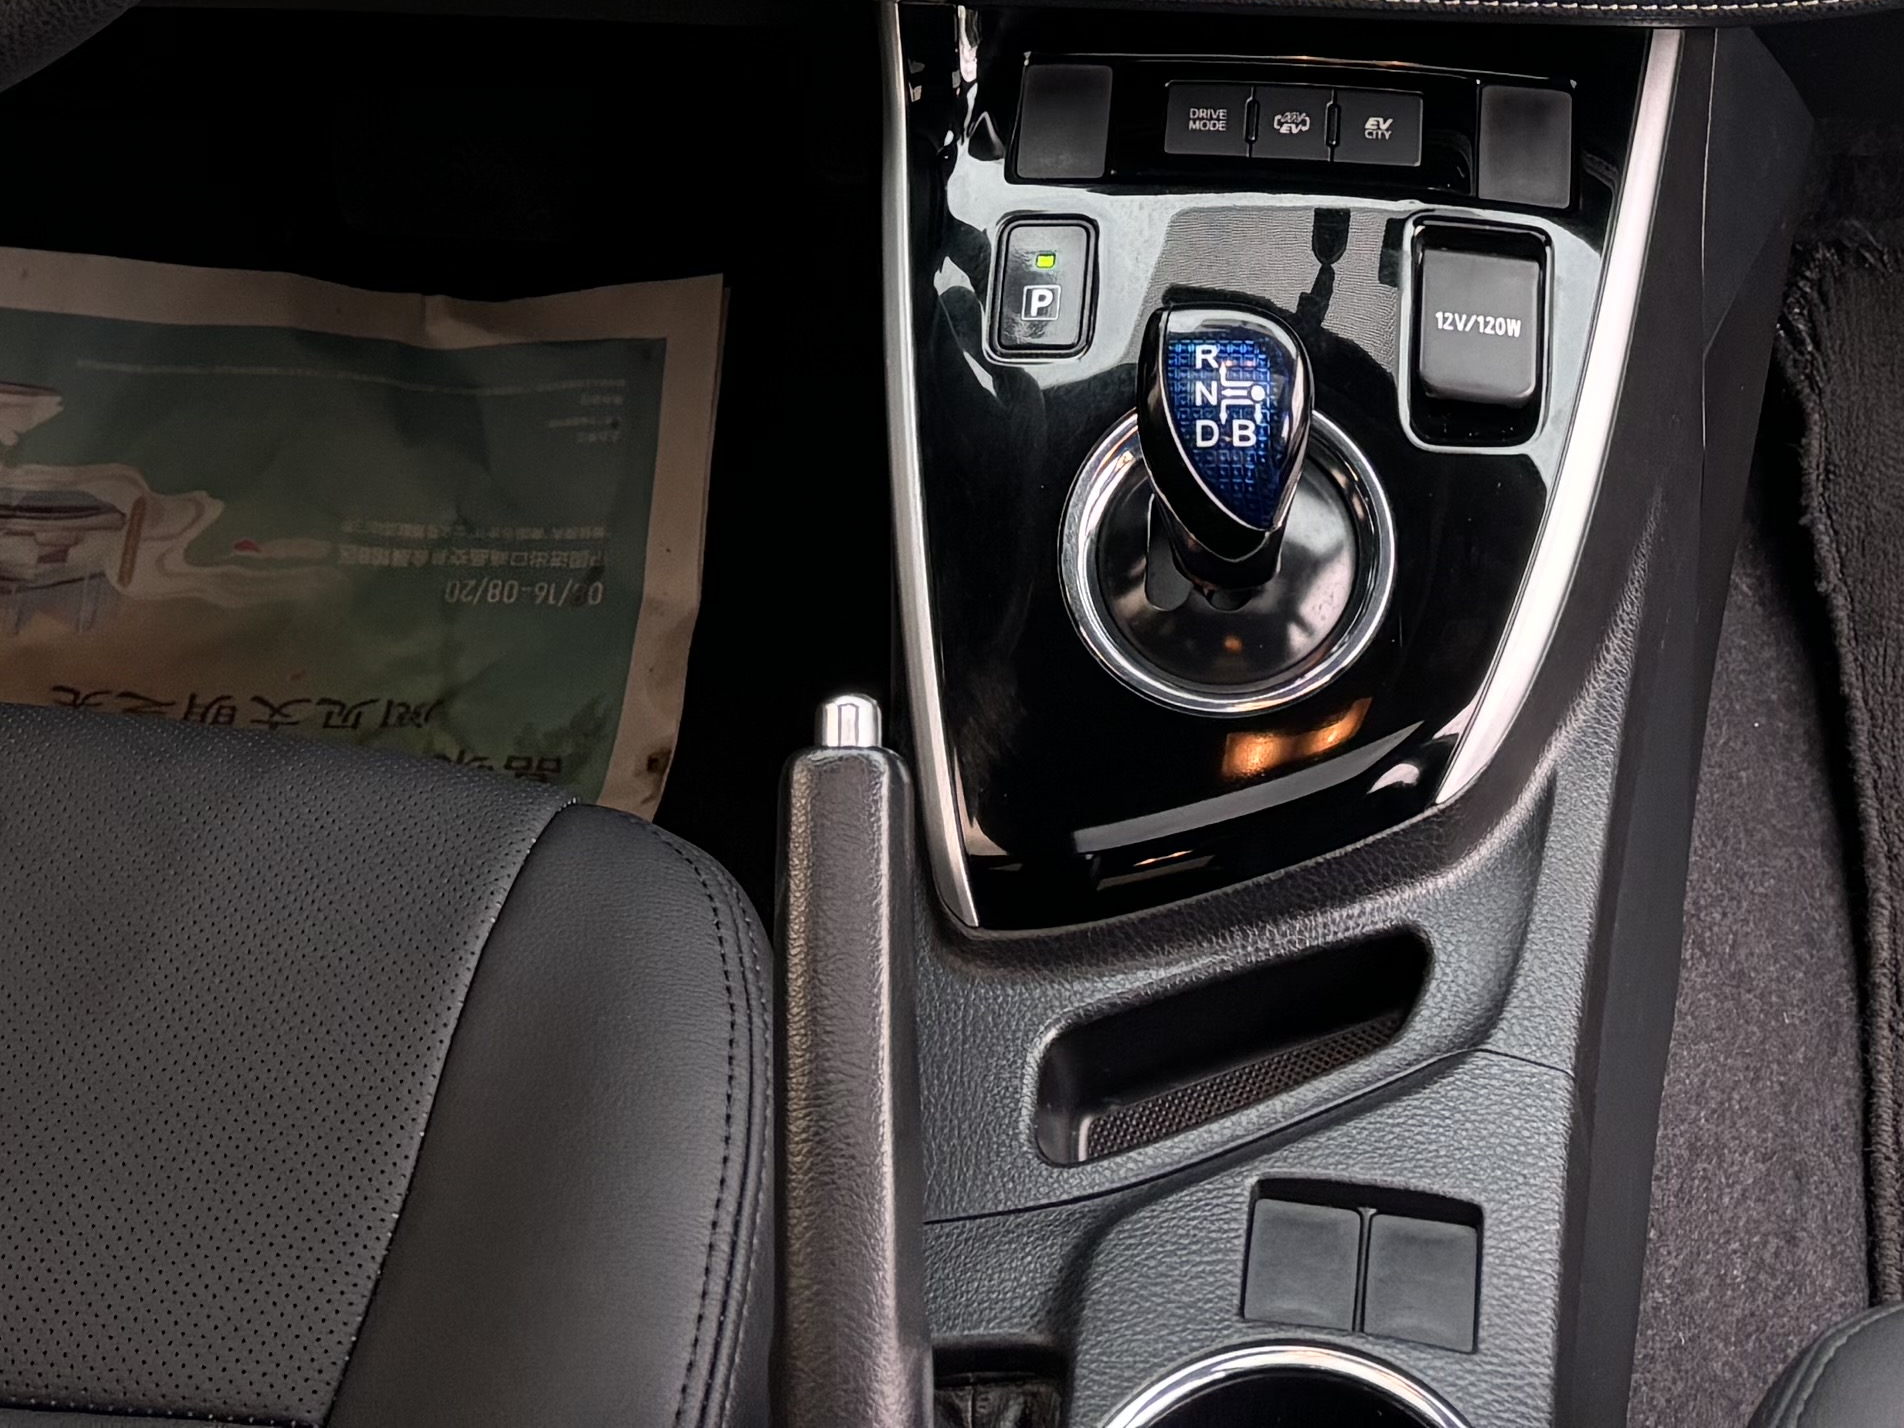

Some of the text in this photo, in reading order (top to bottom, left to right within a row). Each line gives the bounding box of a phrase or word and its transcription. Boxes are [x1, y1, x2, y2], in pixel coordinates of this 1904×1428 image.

[1188, 107, 1228, 120] DRIVE
[1188, 119, 1227, 132] MODE
[1364, 116, 1394, 129] EV
[1364, 129, 1393, 140] CITY
[1030, 290, 1049, 315] P
[1434, 310, 1522, 340] 12V/120W
[1195, 344, 1219, 369] R
[1195, 380, 1218, 406] N
[1195, 418, 1257, 448] D B
